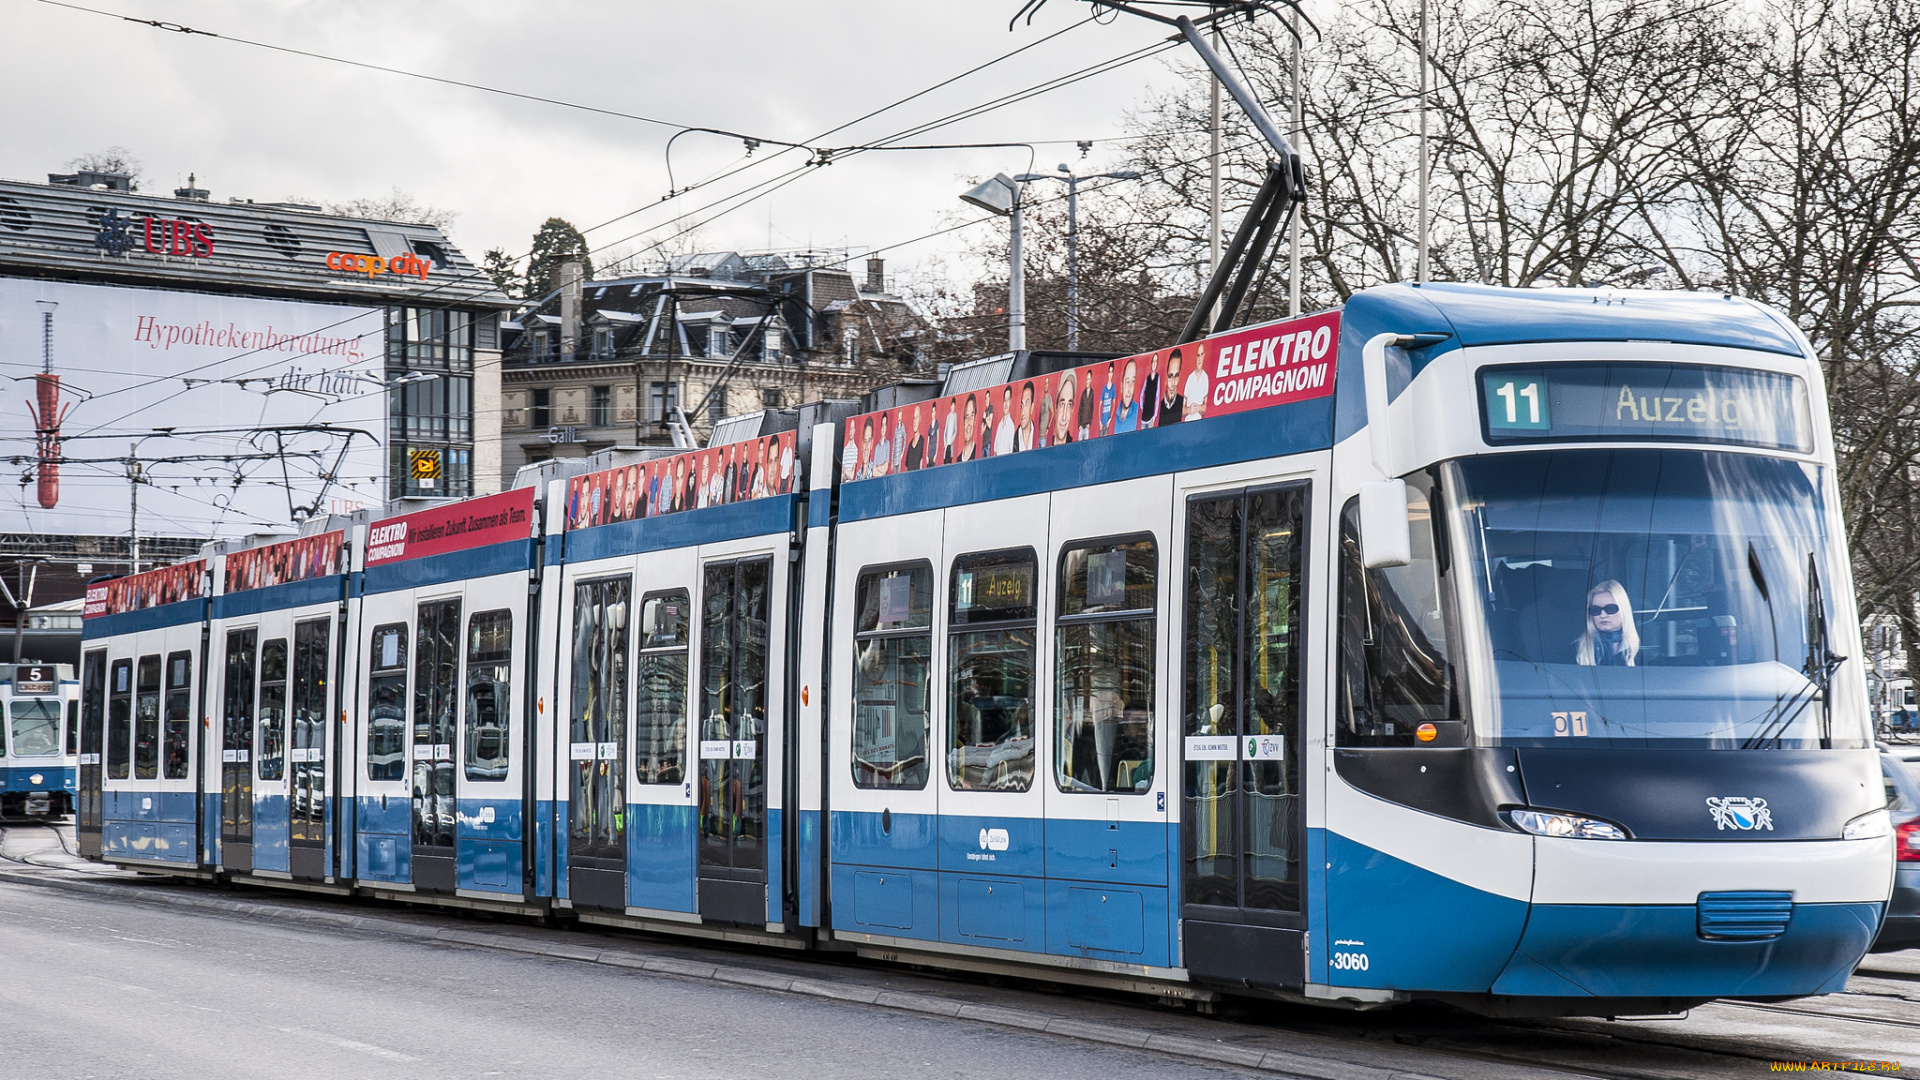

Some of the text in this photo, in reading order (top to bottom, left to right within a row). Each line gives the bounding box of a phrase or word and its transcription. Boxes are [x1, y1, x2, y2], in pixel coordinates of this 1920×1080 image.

[142, 217, 213, 258] UBS
[327, 251, 431, 280] coop city
[134, 315, 364, 363] Hypothekenberatung,
[1216, 325, 1331, 379] ELEKTRO
[281, 366, 311, 390] die
[1213, 363, 1328, 406] COMPAGNONI
[1497, 382, 1540, 423] 11
[1616, 384, 1743, 430] Auzelg
[370, 521, 407, 546] ELEKTRO
[368, 542, 405, 562] COMPAGNONI
[962, 578, 972, 604] 11
[989, 571, 1021, 601] Auzelg
[30, 668, 41, 681] 5
[1334, 952, 1369, 971] 3060
